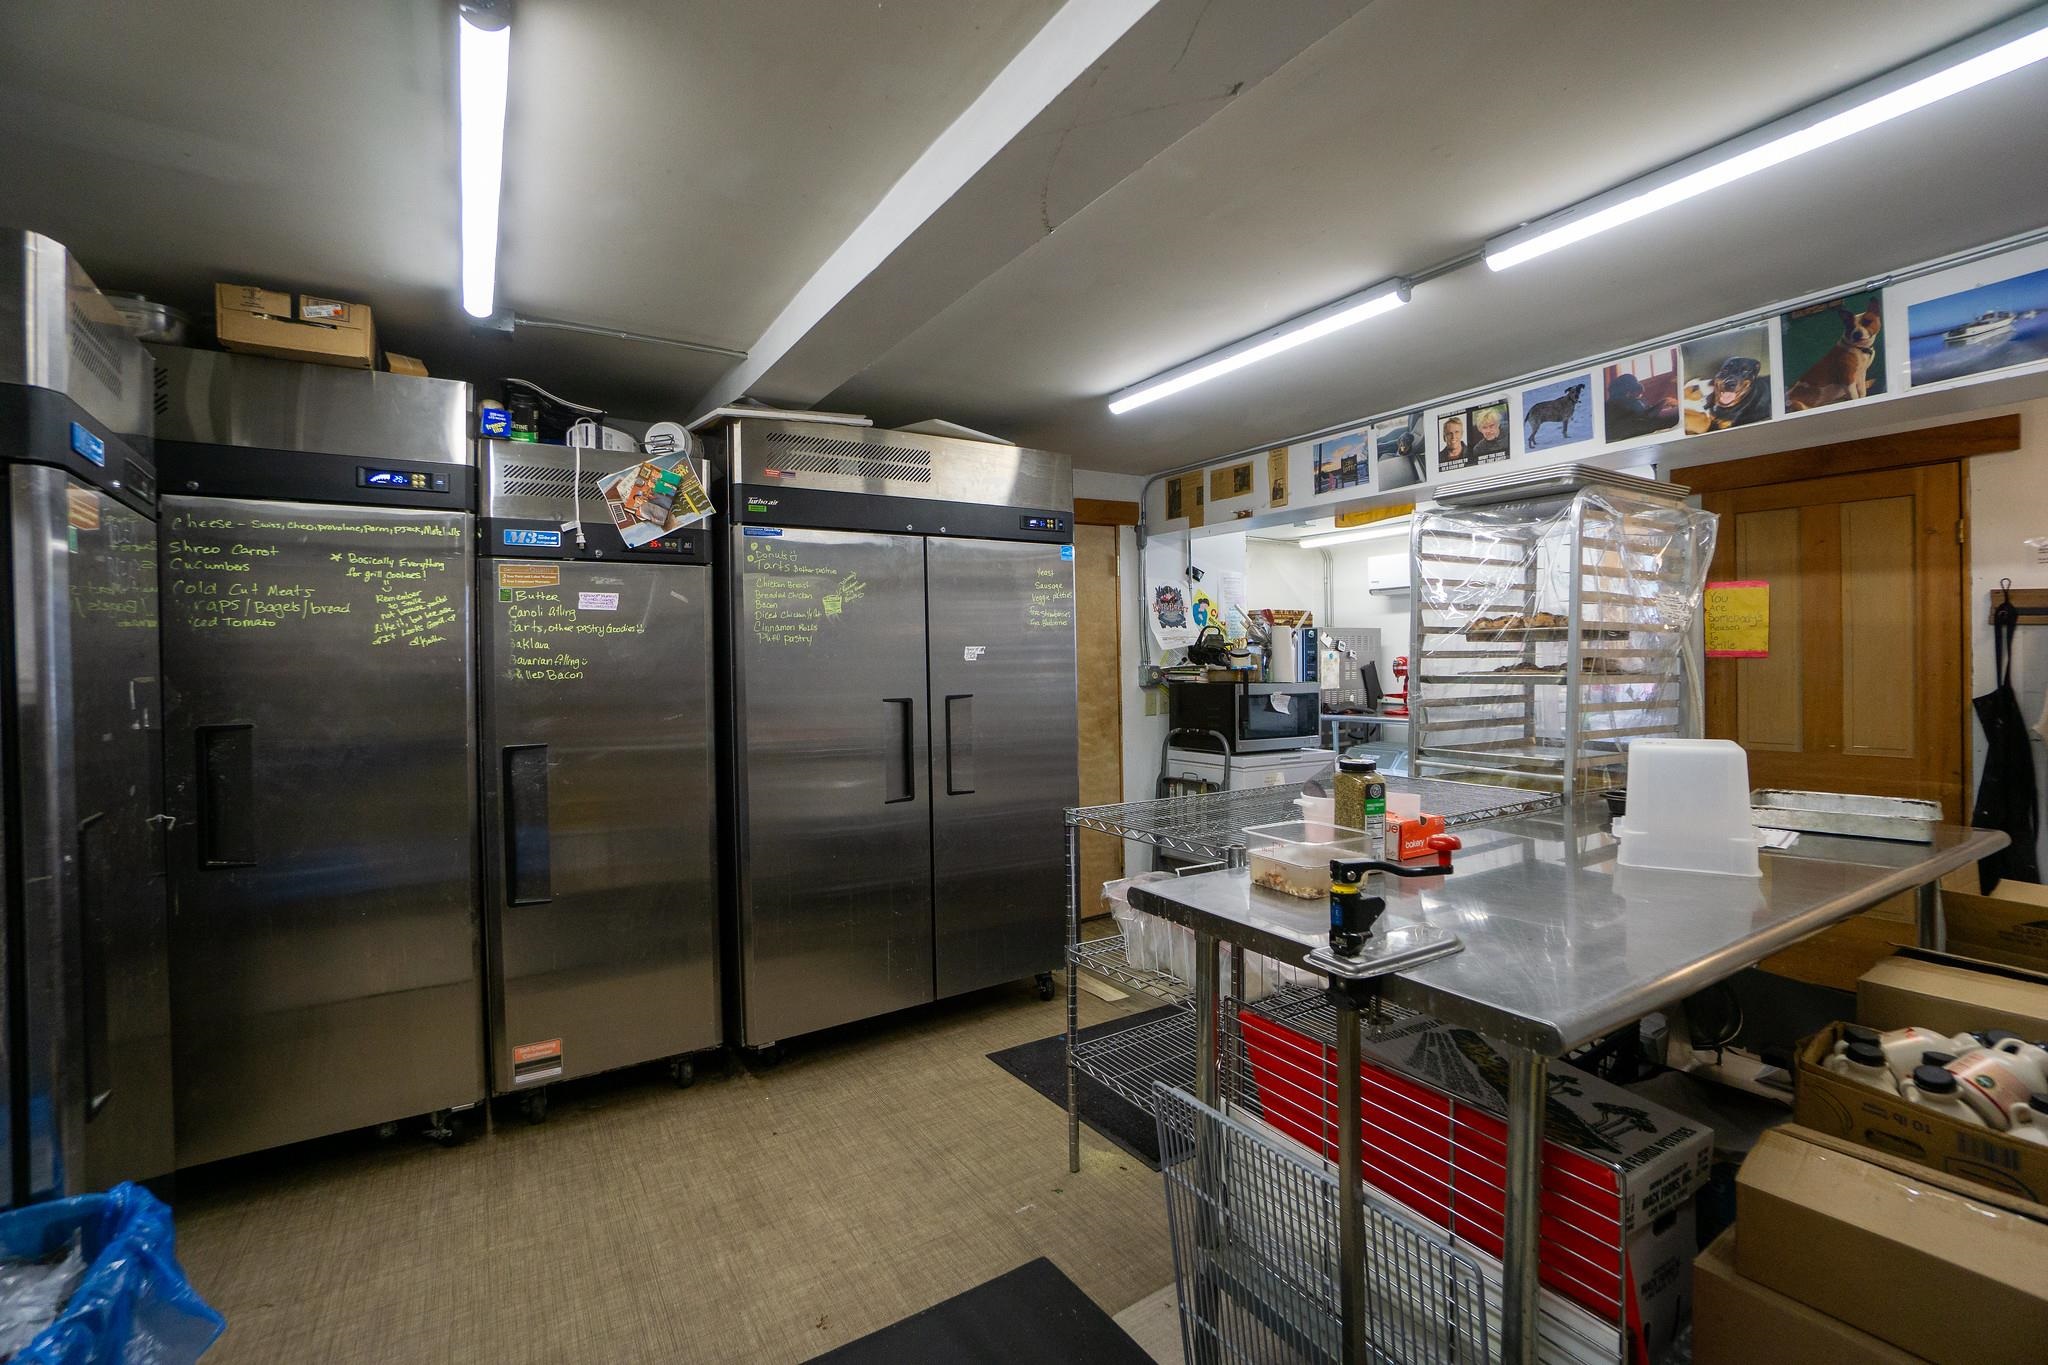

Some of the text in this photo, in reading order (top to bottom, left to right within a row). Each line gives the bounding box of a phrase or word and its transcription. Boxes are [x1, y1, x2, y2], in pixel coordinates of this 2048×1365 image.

[232, 544, 279, 556] Carrot
[348, 552, 394, 567] Basically
[346, 567, 362, 577] for
[365, 570, 382, 583] grill
[173, 580, 315, 598] Cold Cut Meats
[222, 617, 276, 627] Tomato
[546, 669, 583, 681] Bacon
[1405, 839, 1425, 849] bakery
